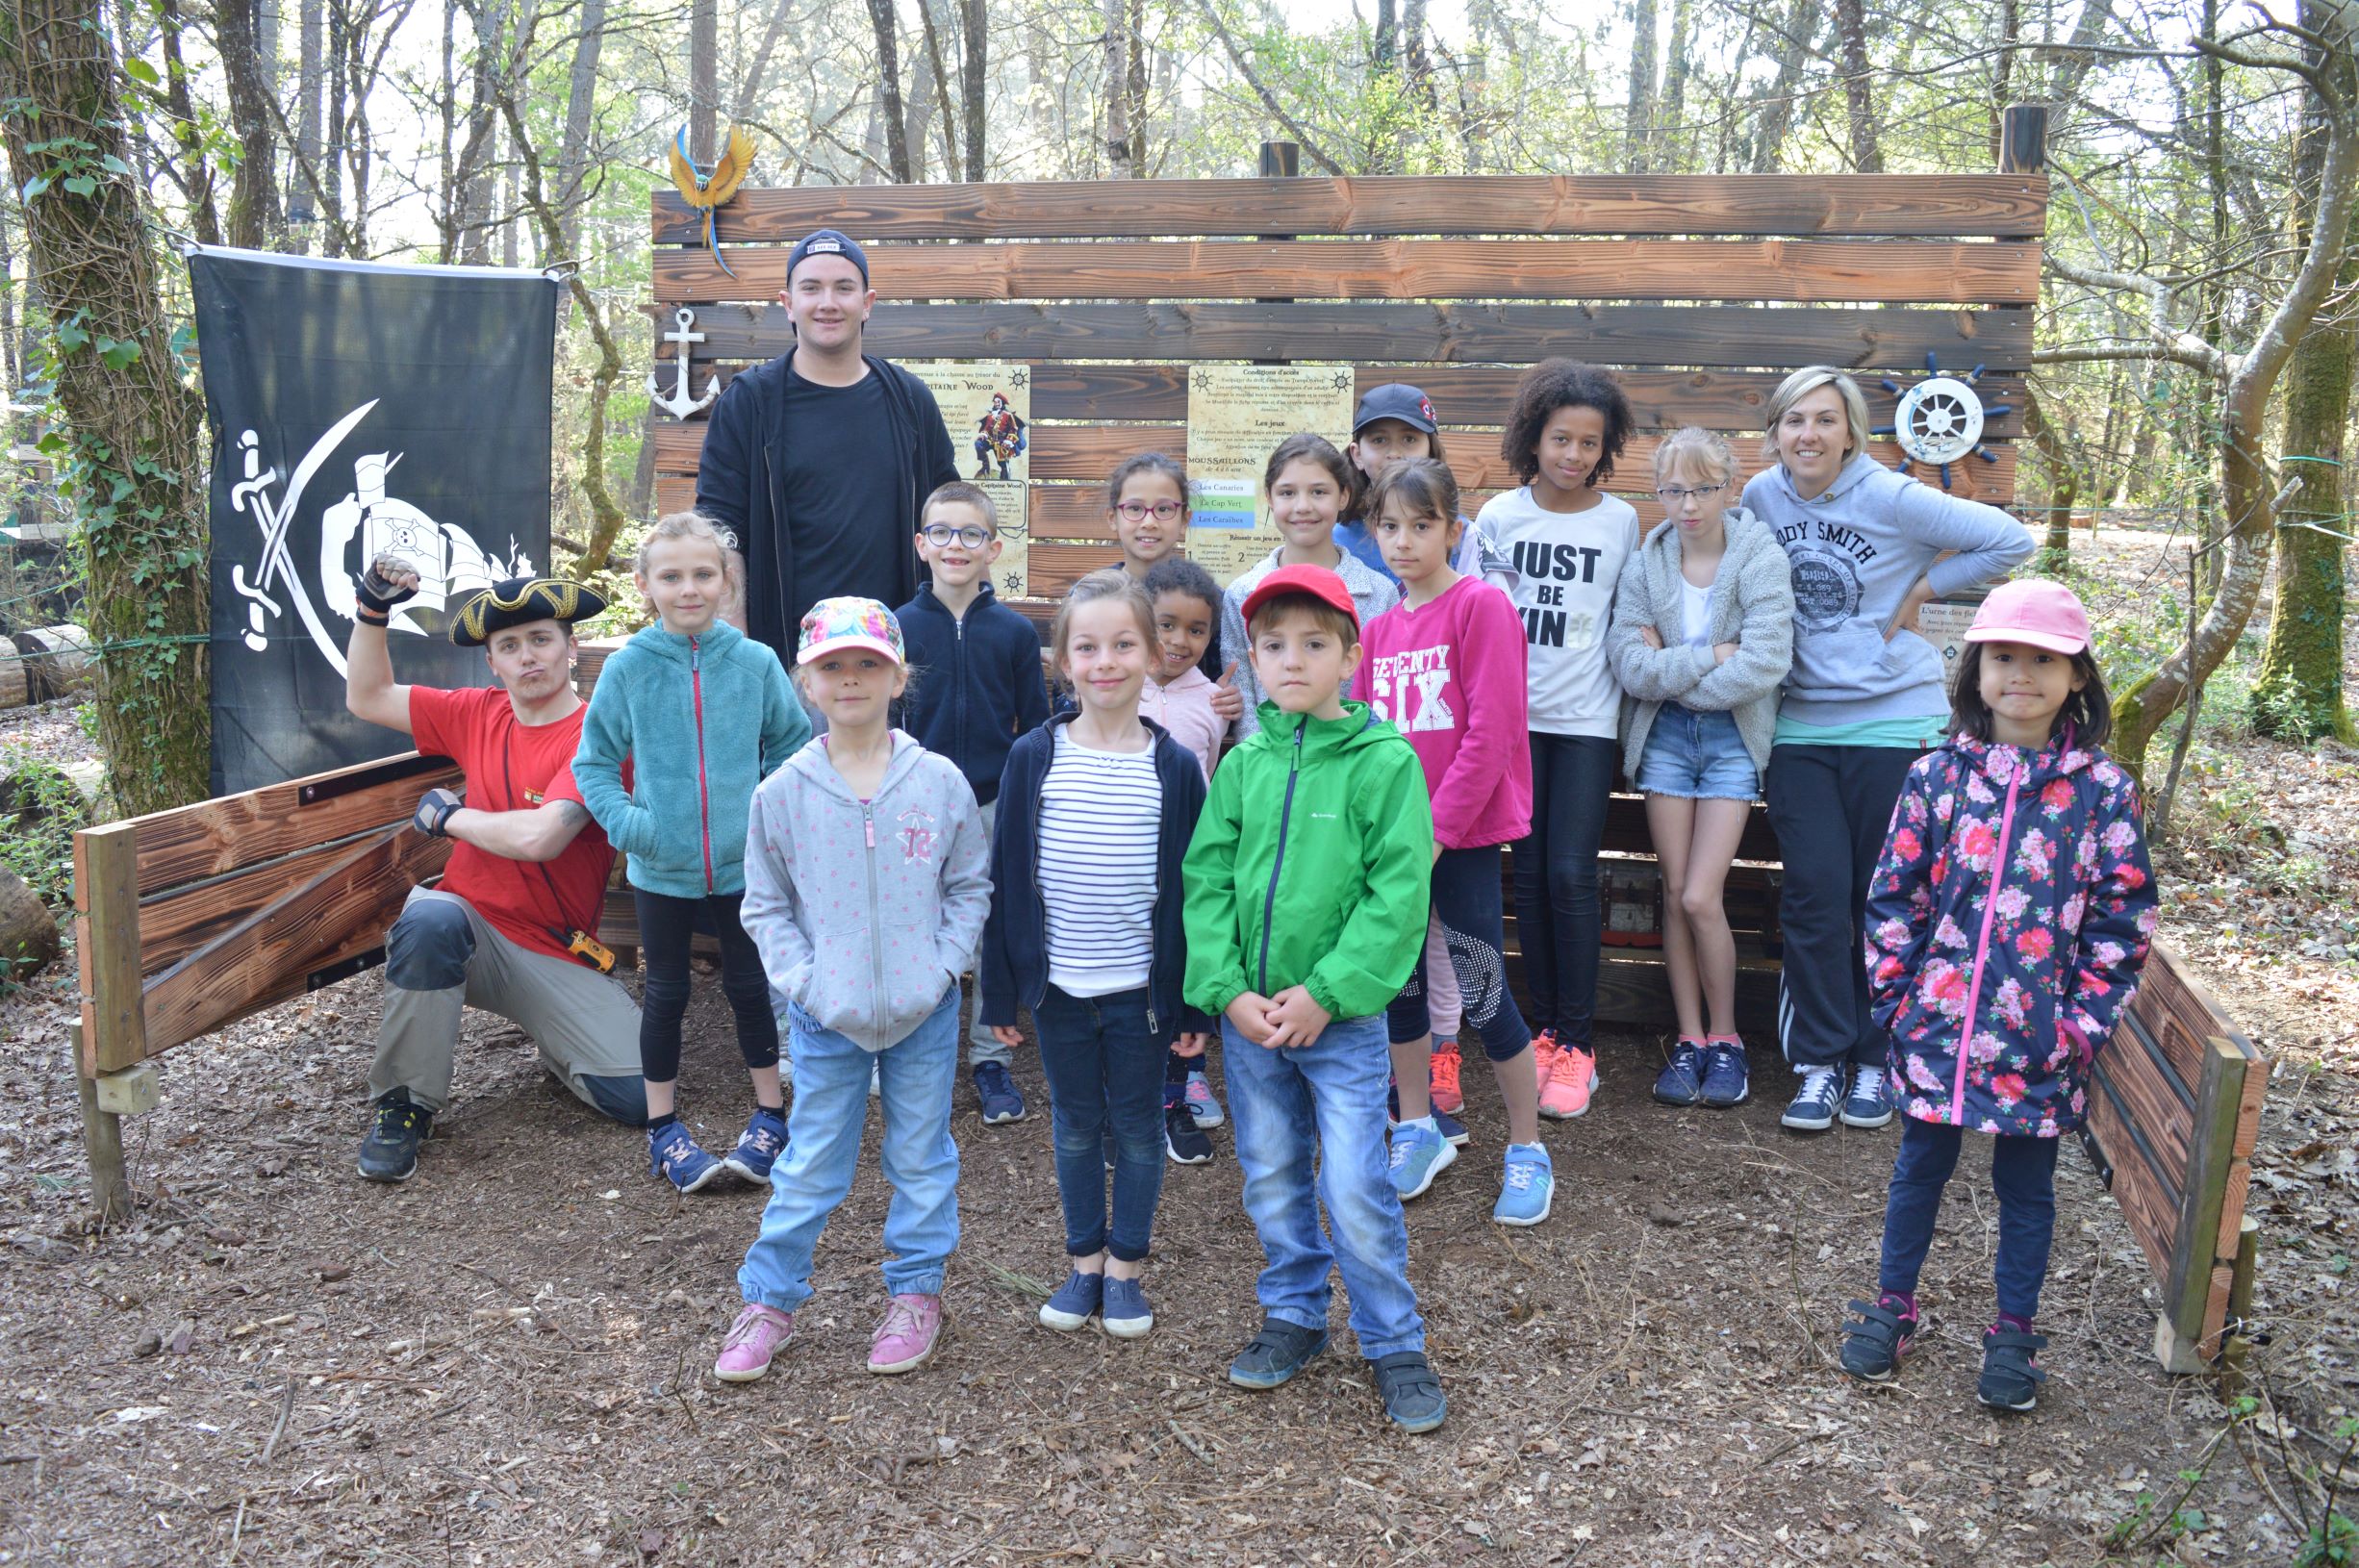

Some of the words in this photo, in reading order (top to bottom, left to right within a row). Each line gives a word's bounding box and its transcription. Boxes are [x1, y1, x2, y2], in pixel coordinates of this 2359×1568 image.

[1213, 483, 1244, 492] Canaries
[1211, 499, 1226, 508] Cap
[1228, 499, 1242, 508] Vert
[1776, 521, 1808, 547] ODY
[1817, 520, 1877, 565] SMITH
[1238, 551, 1245, 563] 2
[1512, 541, 1602, 583] JUST
[1536, 584, 1564, 606] BE
[1921, 607, 1947, 616] L'urne
[1373, 669, 1455, 735] SIX
